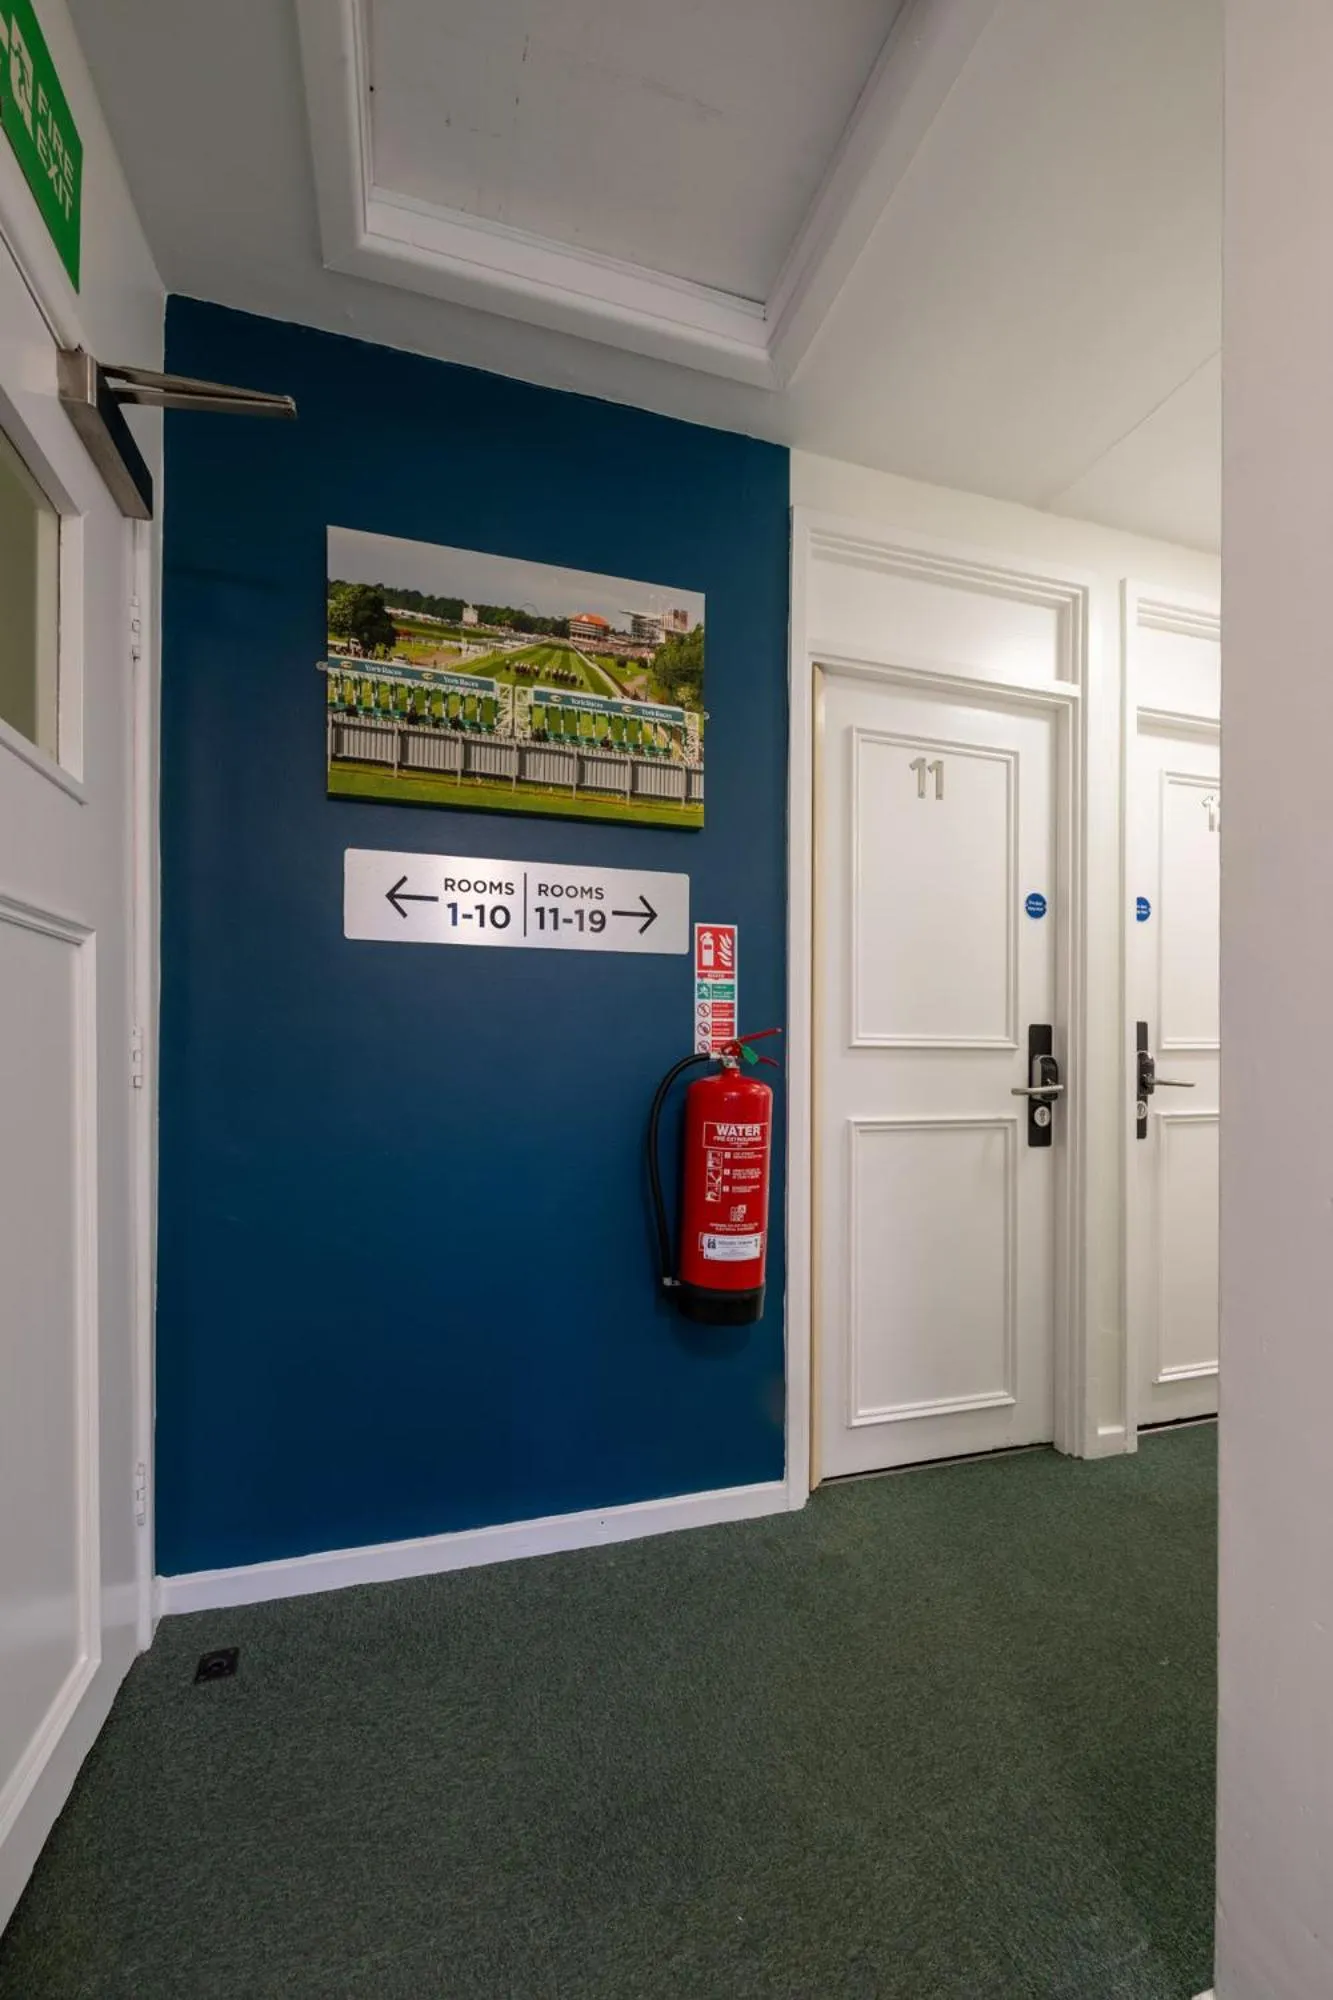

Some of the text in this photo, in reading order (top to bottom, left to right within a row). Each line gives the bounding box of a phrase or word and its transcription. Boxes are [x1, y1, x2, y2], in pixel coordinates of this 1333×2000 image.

[38, 82, 74, 194] FIRE
[37, 121, 73, 222] EXIT
[909, 757, 944, 800] 11
[1201, 795, 1220, 832] 1
[444, 878, 515, 896] ROOMS
[538, 884, 604, 900] ROOMS
[447, 902, 511, 930] 1-10
[535, 906, 606, 933] 11-19
[716, 1124, 760, 1136] WATER
